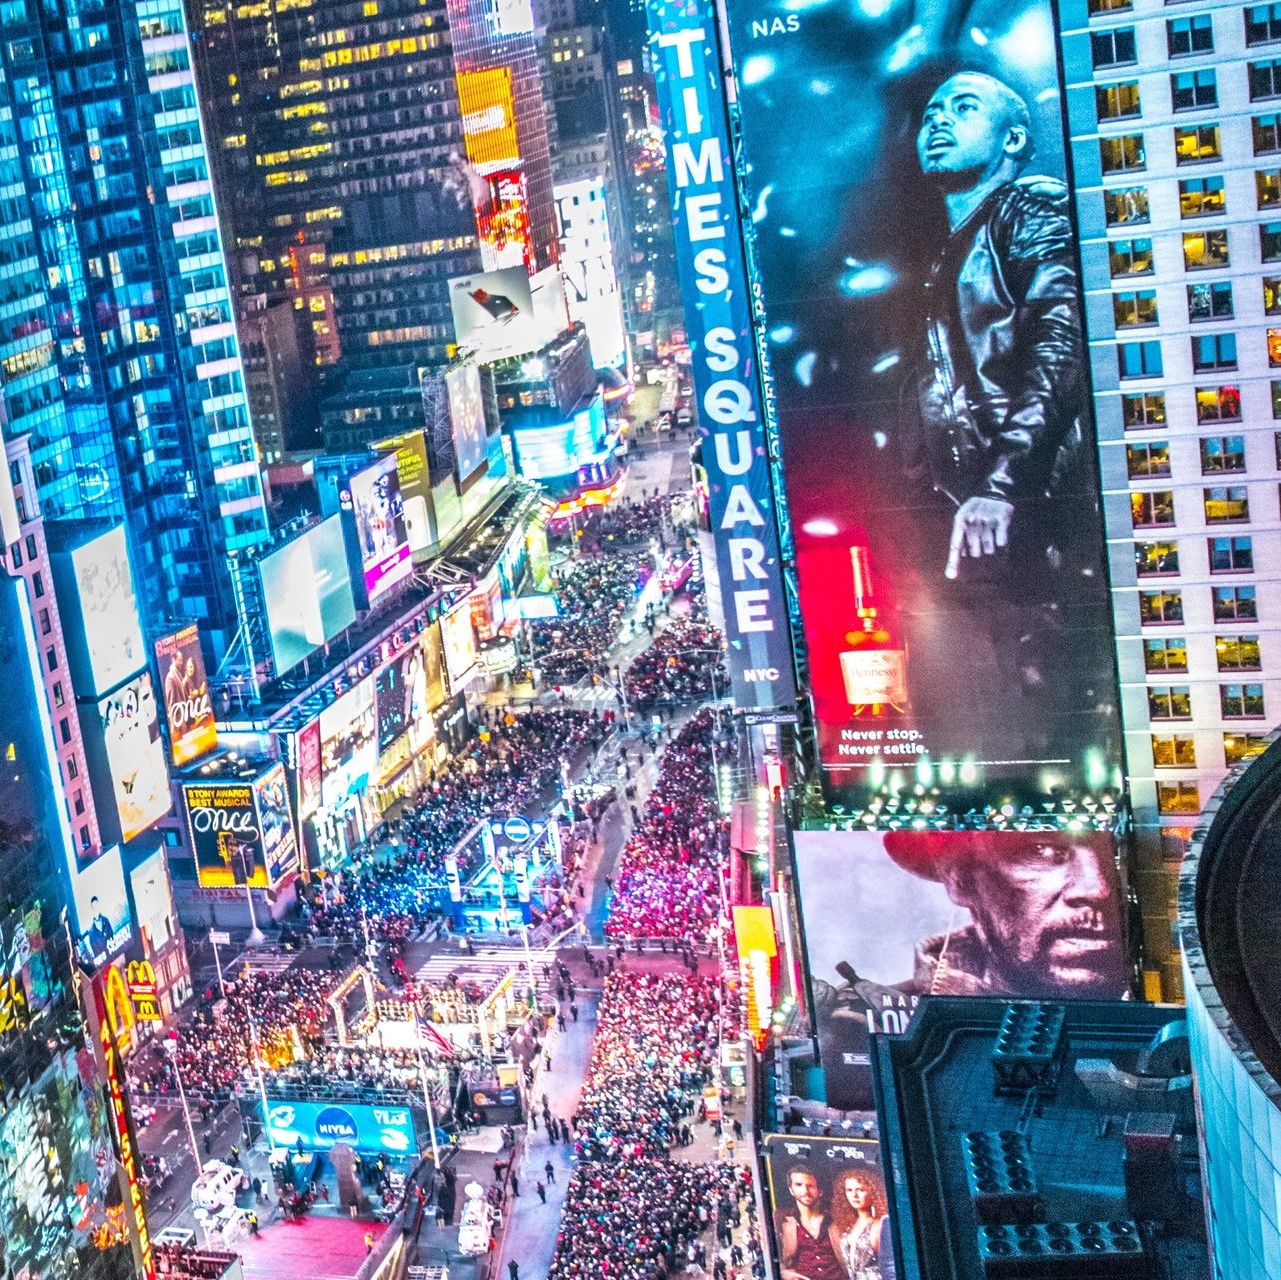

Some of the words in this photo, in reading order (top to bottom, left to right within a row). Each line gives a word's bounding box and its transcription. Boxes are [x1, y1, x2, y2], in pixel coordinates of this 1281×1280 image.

[752, 14, 801, 39] NAS
[658, 28, 729, 294] TIMES
[704, 326, 774, 634] SQUARE
[743, 668, 779, 682] NYC
[841, 729, 882, 740] Never
[886, 729, 923, 741] stop.
[838, 744, 880, 755] Never
[883, 742, 929, 755] settle.
[215, 789, 250, 797] AWARDS
[189, 798, 213, 807] BEST
[214, 797, 252, 807] MUSICAL
[882, 995, 919, 1007] MAR
[319, 1123, 354, 1135] NIVEA
[121, 1132, 152, 1273] STREET
